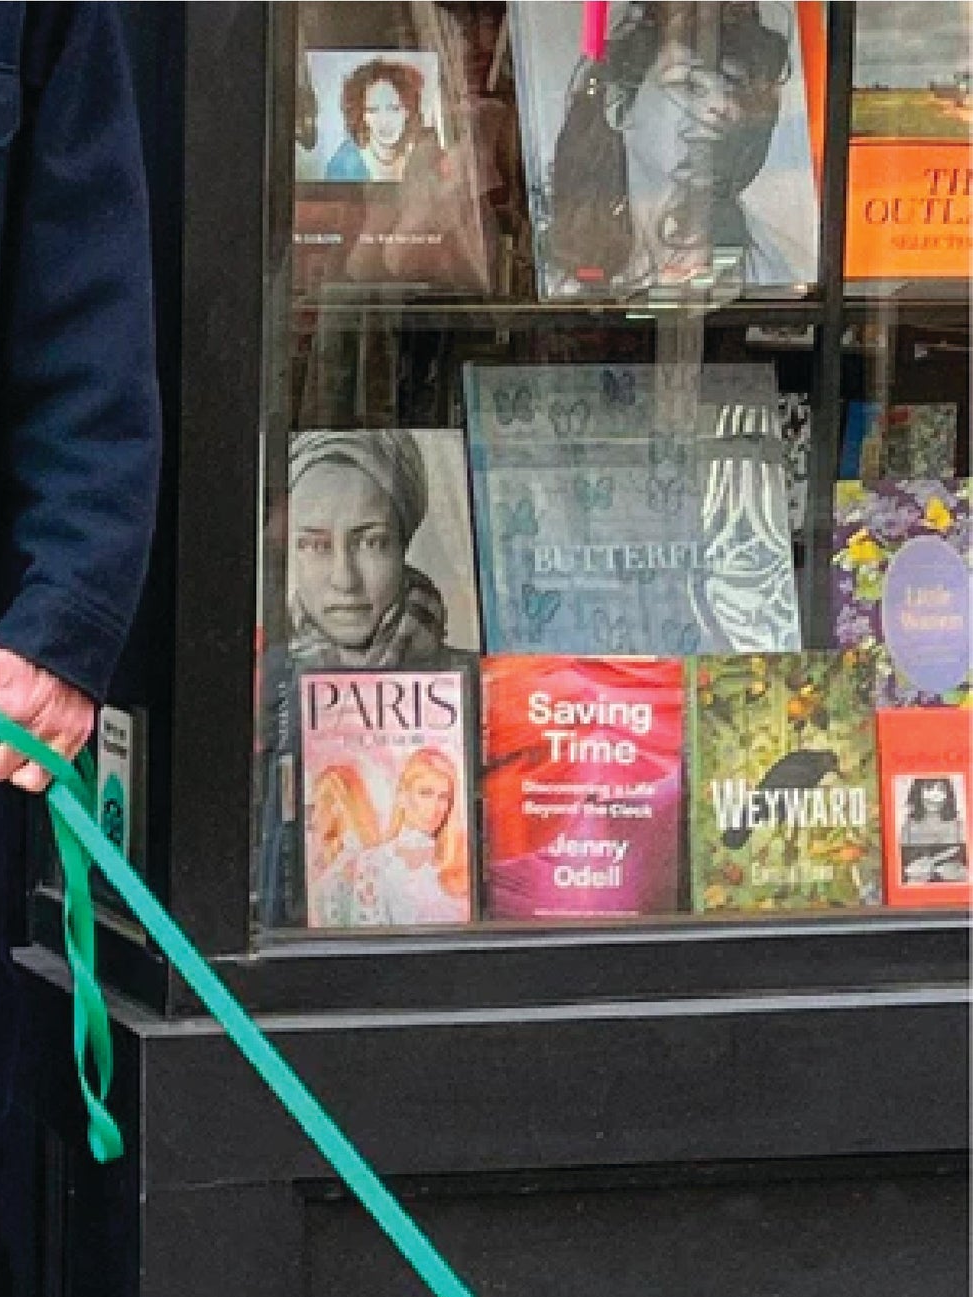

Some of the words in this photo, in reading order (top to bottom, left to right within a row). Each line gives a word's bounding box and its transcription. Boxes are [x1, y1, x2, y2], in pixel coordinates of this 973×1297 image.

[865, 197, 970, 225] OUTL
[308, 681, 457, 730] PARIS
[528, 690, 652, 735] Saving
[542, 729, 637, 764] Time
[710, 778, 867, 832] WEYWARD
[547, 832, 629, 864] Jenny
[553, 864, 621, 889] Odell
